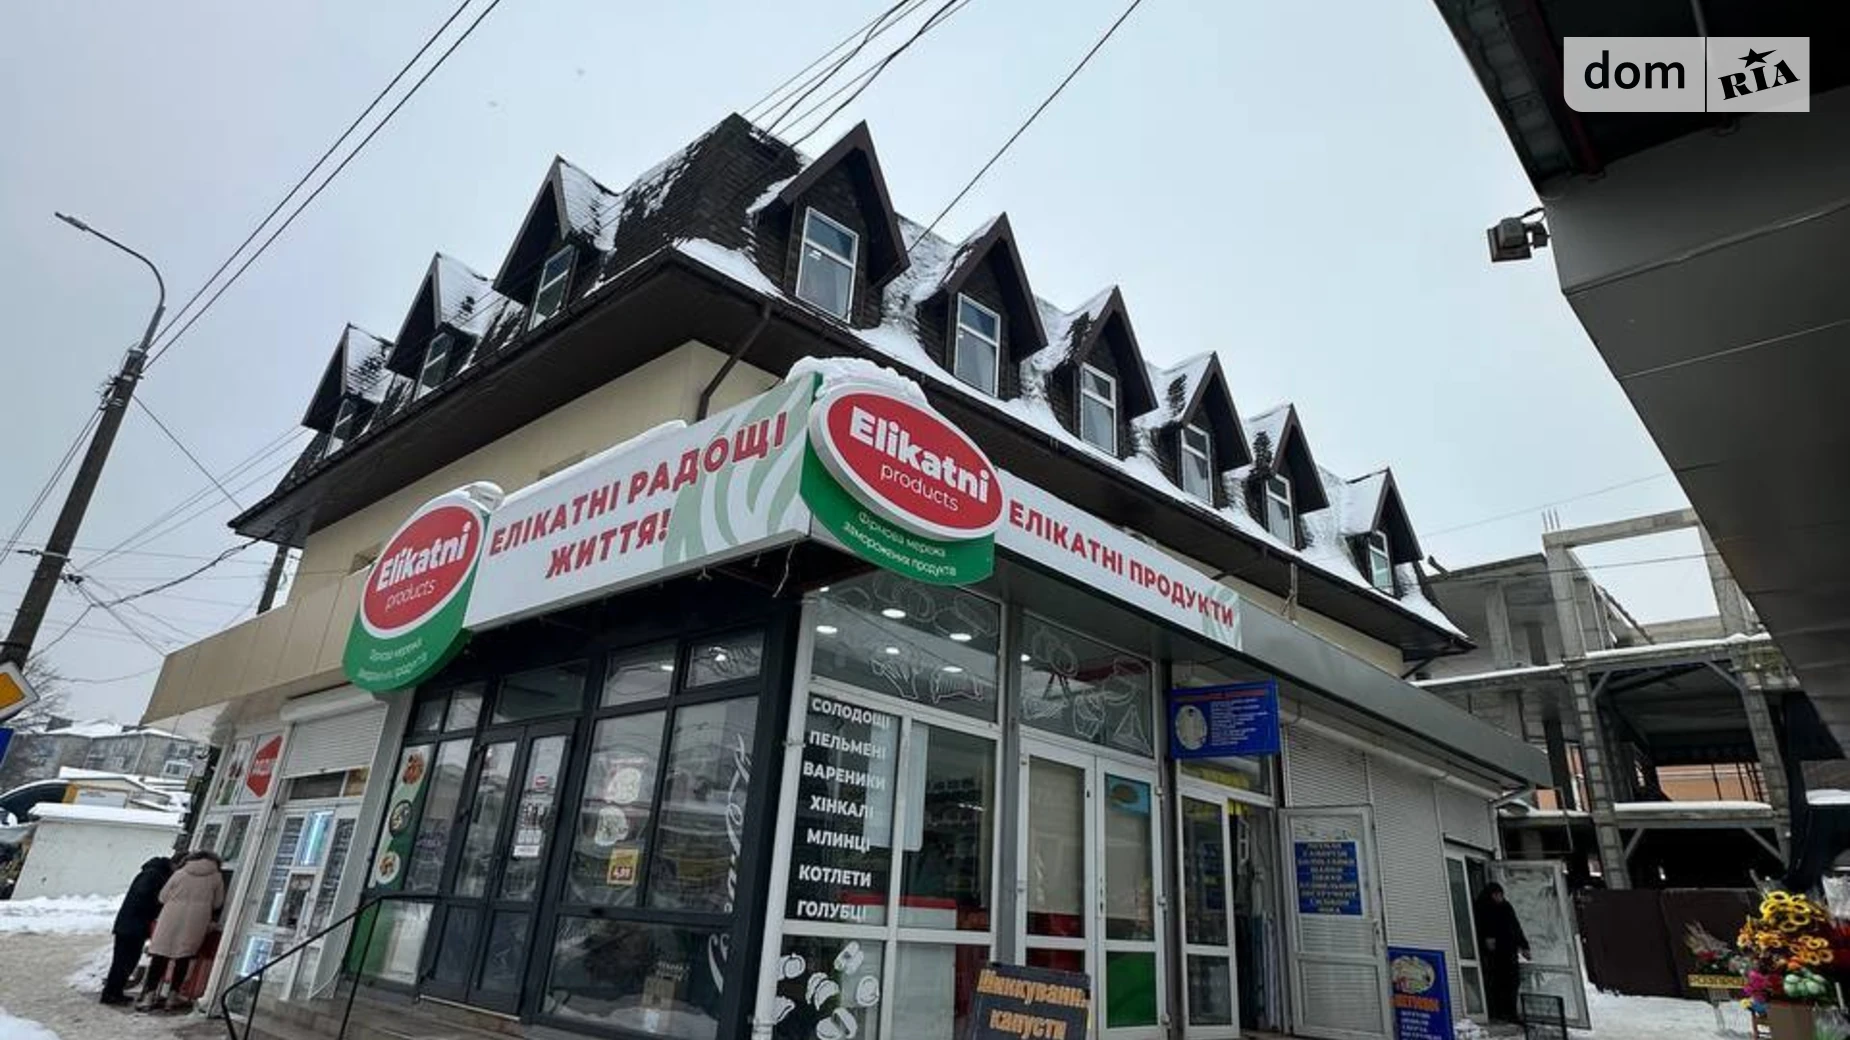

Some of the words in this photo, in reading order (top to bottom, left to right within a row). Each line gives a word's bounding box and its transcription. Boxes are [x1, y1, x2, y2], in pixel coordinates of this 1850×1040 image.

[850, 405, 990, 504] Elikatni
[490, 481, 621, 556] ЕЛІКАТНІ
[627, 412, 788, 504] РАДОЩІ
[880, 464, 960, 512] products
[375, 520, 472, 592] Elikatni
[545, 508, 671, 579] ЖИТТЯ!
[1009, 498, 1124, 575] ЕЛІКАТНІ
[1129, 559, 1234, 628] ПРОДУКТИ
[384, 578, 437, 613] products
[811, 697, 890, 729] СОЛОДОЩІ
[809, 731, 887, 760] ПЕЛЬМЕНІ
[803, 761, 886, 790] ВАРЕНИКИ
[809, 795, 874, 819] ХІНКАЛІ
[806, 828, 871, 853] МЛИНЦІ
[798, 864, 872, 888] КОТЛЕТИ
[796, 900, 867, 922] ГОЛУБЦІ
